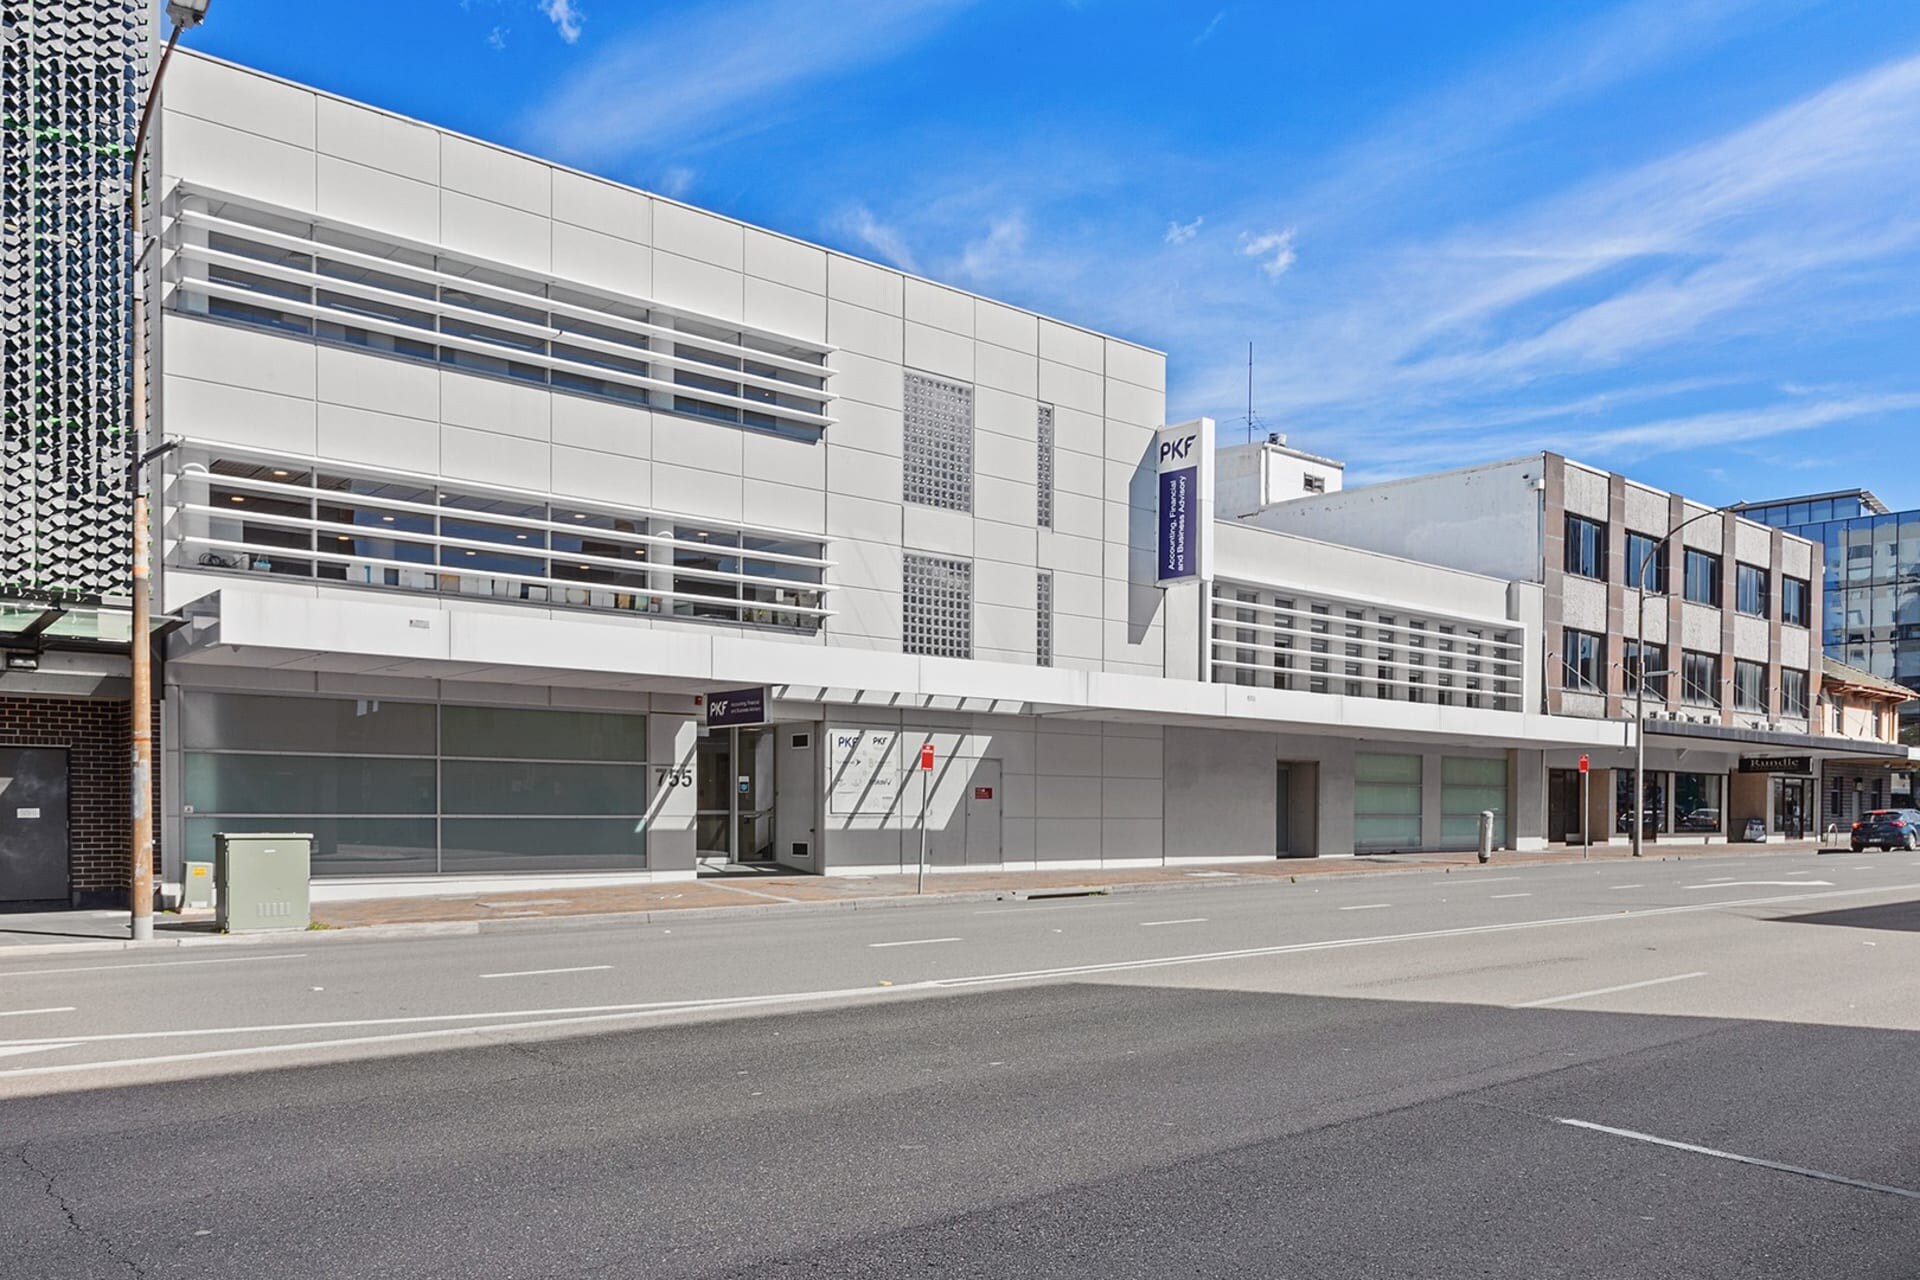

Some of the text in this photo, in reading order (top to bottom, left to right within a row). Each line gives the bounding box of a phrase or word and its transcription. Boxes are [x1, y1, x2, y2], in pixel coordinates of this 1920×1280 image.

[1160, 435, 1196, 464] PKF
[1178, 475, 1187, 512] Advisory
[1168, 519, 1177, 570] Accounting,
[1177, 514, 1185, 553] Business
[710, 700, 729, 717] PKF
[838, 736, 859, 748] PKF
[1751, 758, 1800, 767] Rundle
[655, 768, 692, 787] 755
